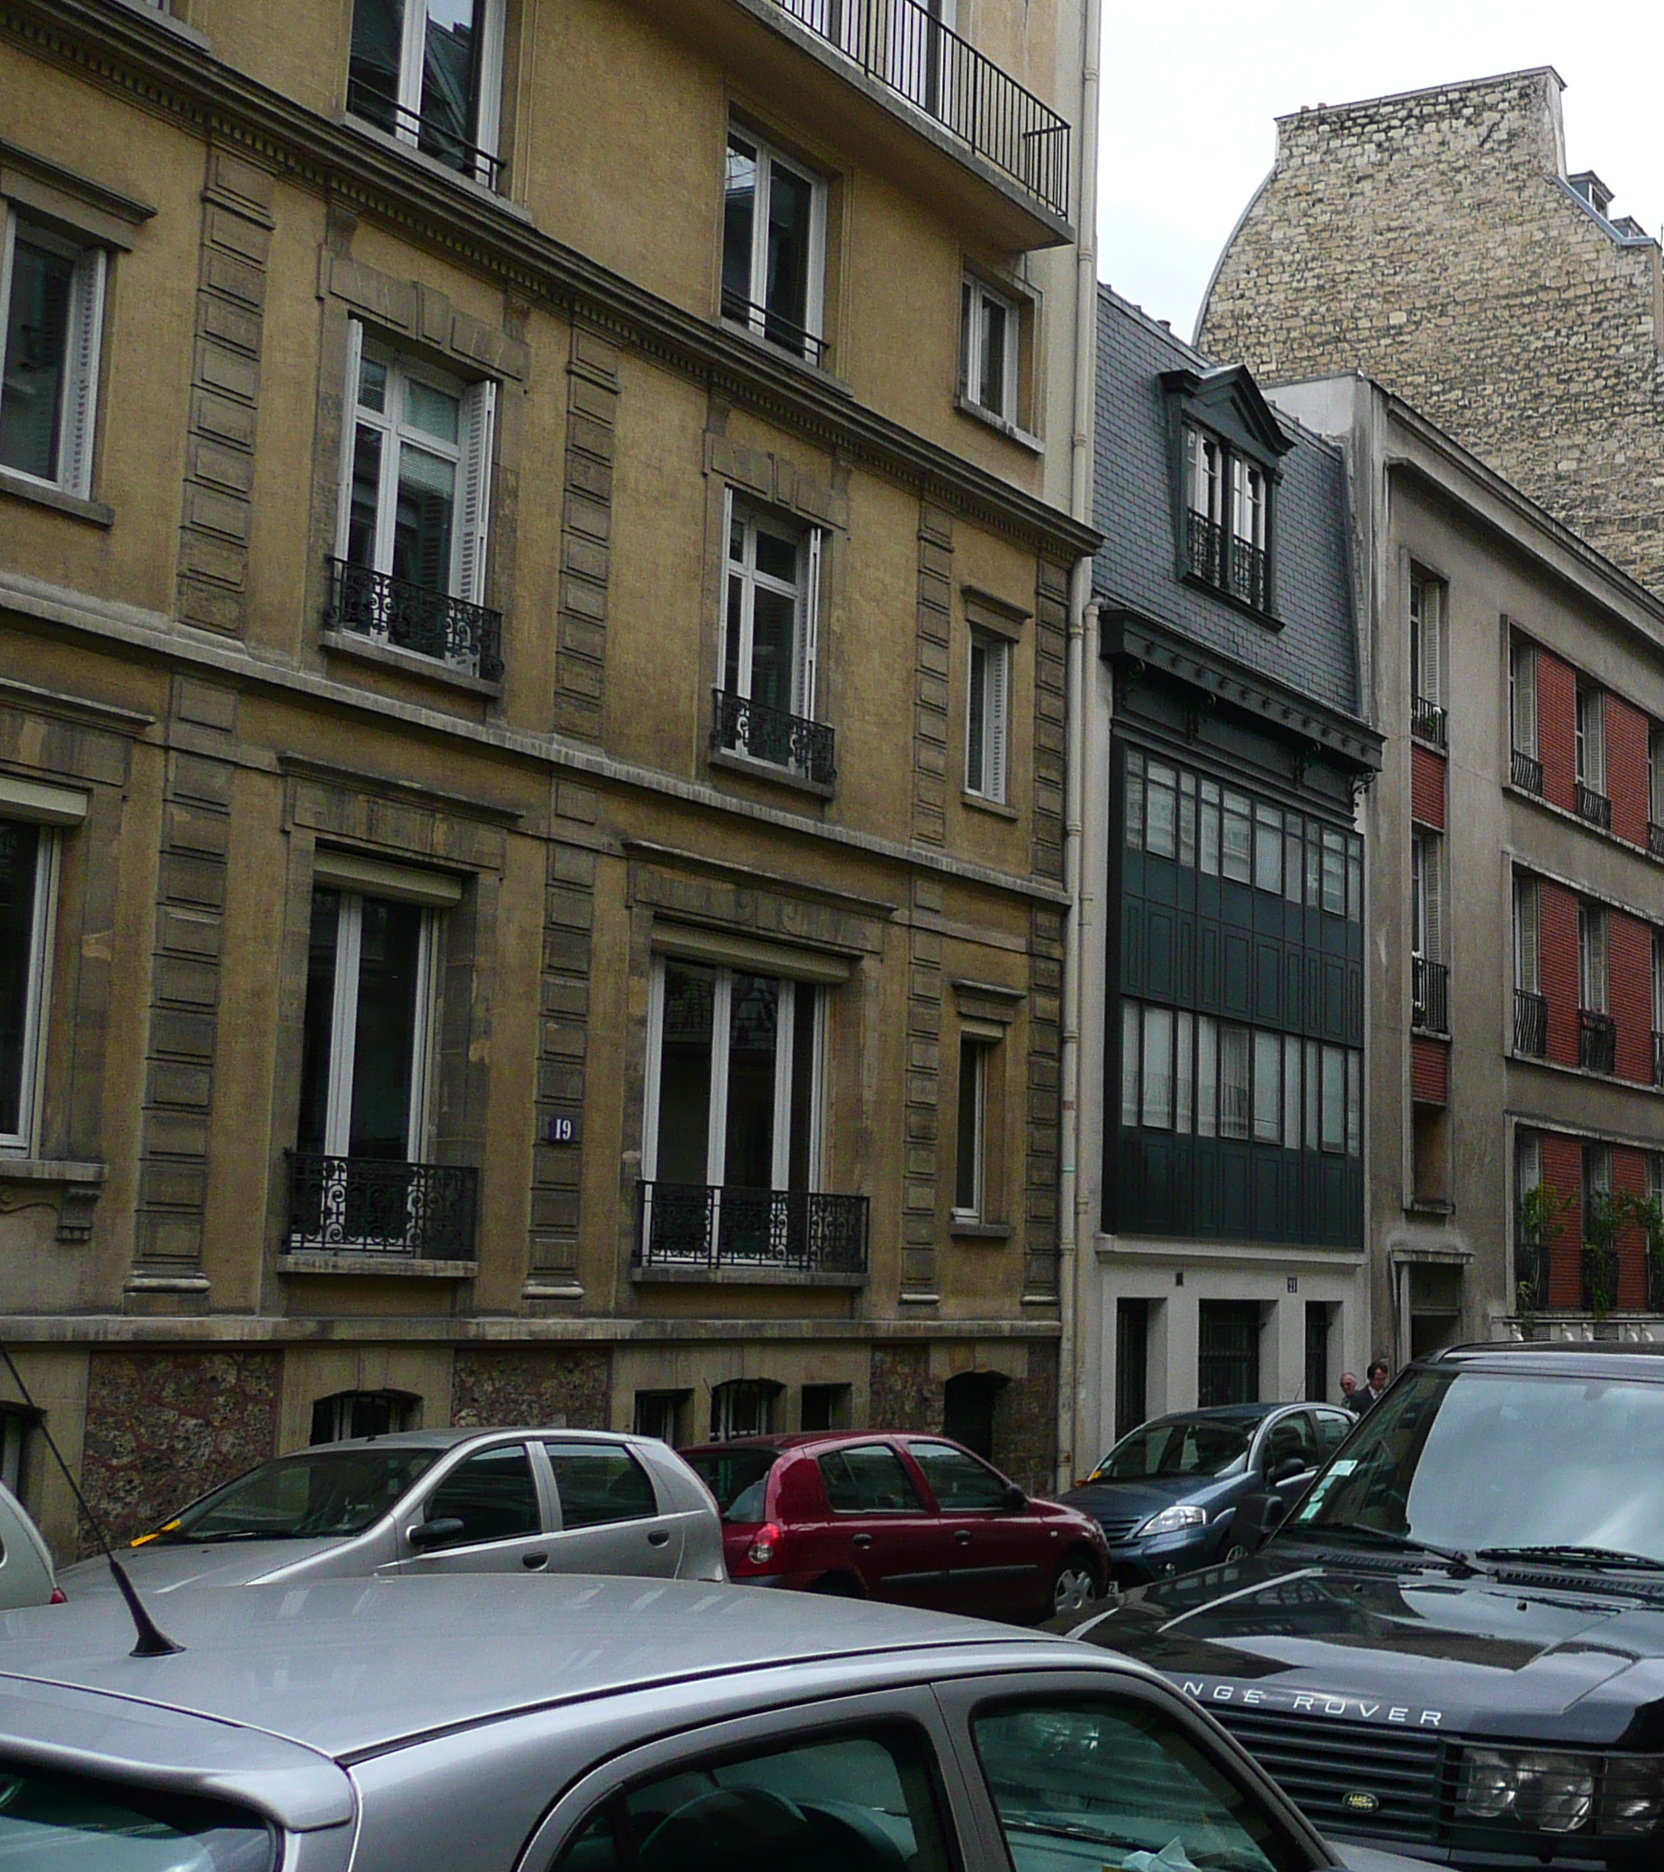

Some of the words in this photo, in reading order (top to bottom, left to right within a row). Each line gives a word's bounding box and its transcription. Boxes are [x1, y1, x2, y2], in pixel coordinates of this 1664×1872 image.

[555, 1118, 572, 1140] 19
[1182, 1681, 1264, 1705] NGE
[1292, 1695, 1442, 1726] ROVER
